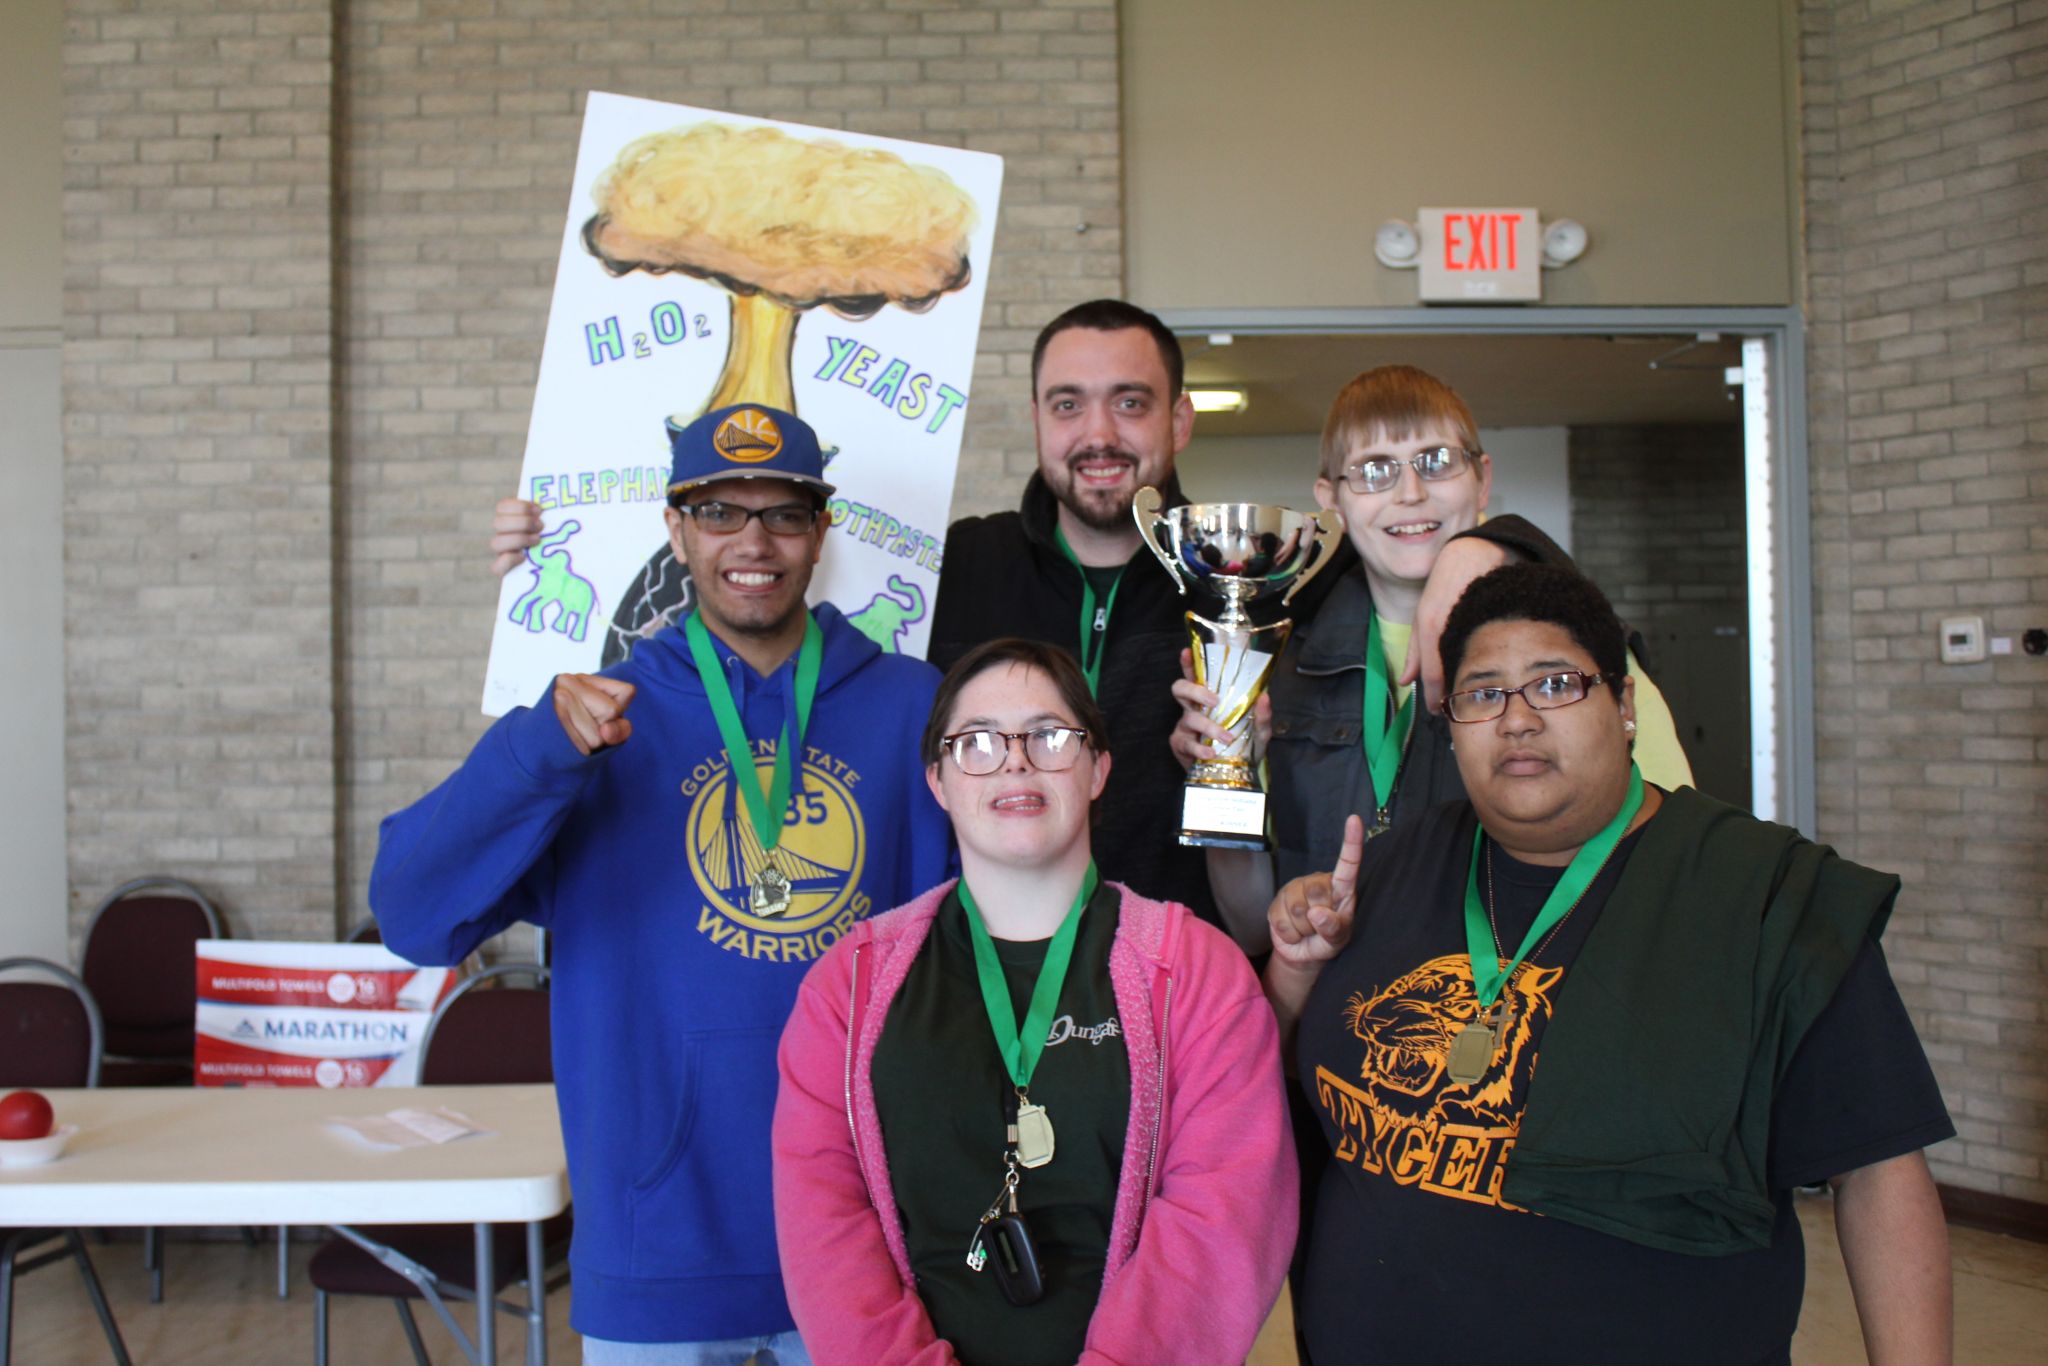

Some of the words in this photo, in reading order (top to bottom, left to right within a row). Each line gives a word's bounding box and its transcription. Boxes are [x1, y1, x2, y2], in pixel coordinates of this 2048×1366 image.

[1444, 214, 1522, 270] EXIT
[814, 335, 967, 434] YEAST
[805, 746, 862, 789] TATE
[696, 890, 872, 963] WARRIORS
[211, 976, 277, 992] MULTIFOLD
[279, 979, 324, 993] TOWELS
[264, 1020, 408, 1042] MARATHON
[200, 1062, 265, 1077] MULTIFOLD
[267, 1064, 312, 1079] TOWELS
